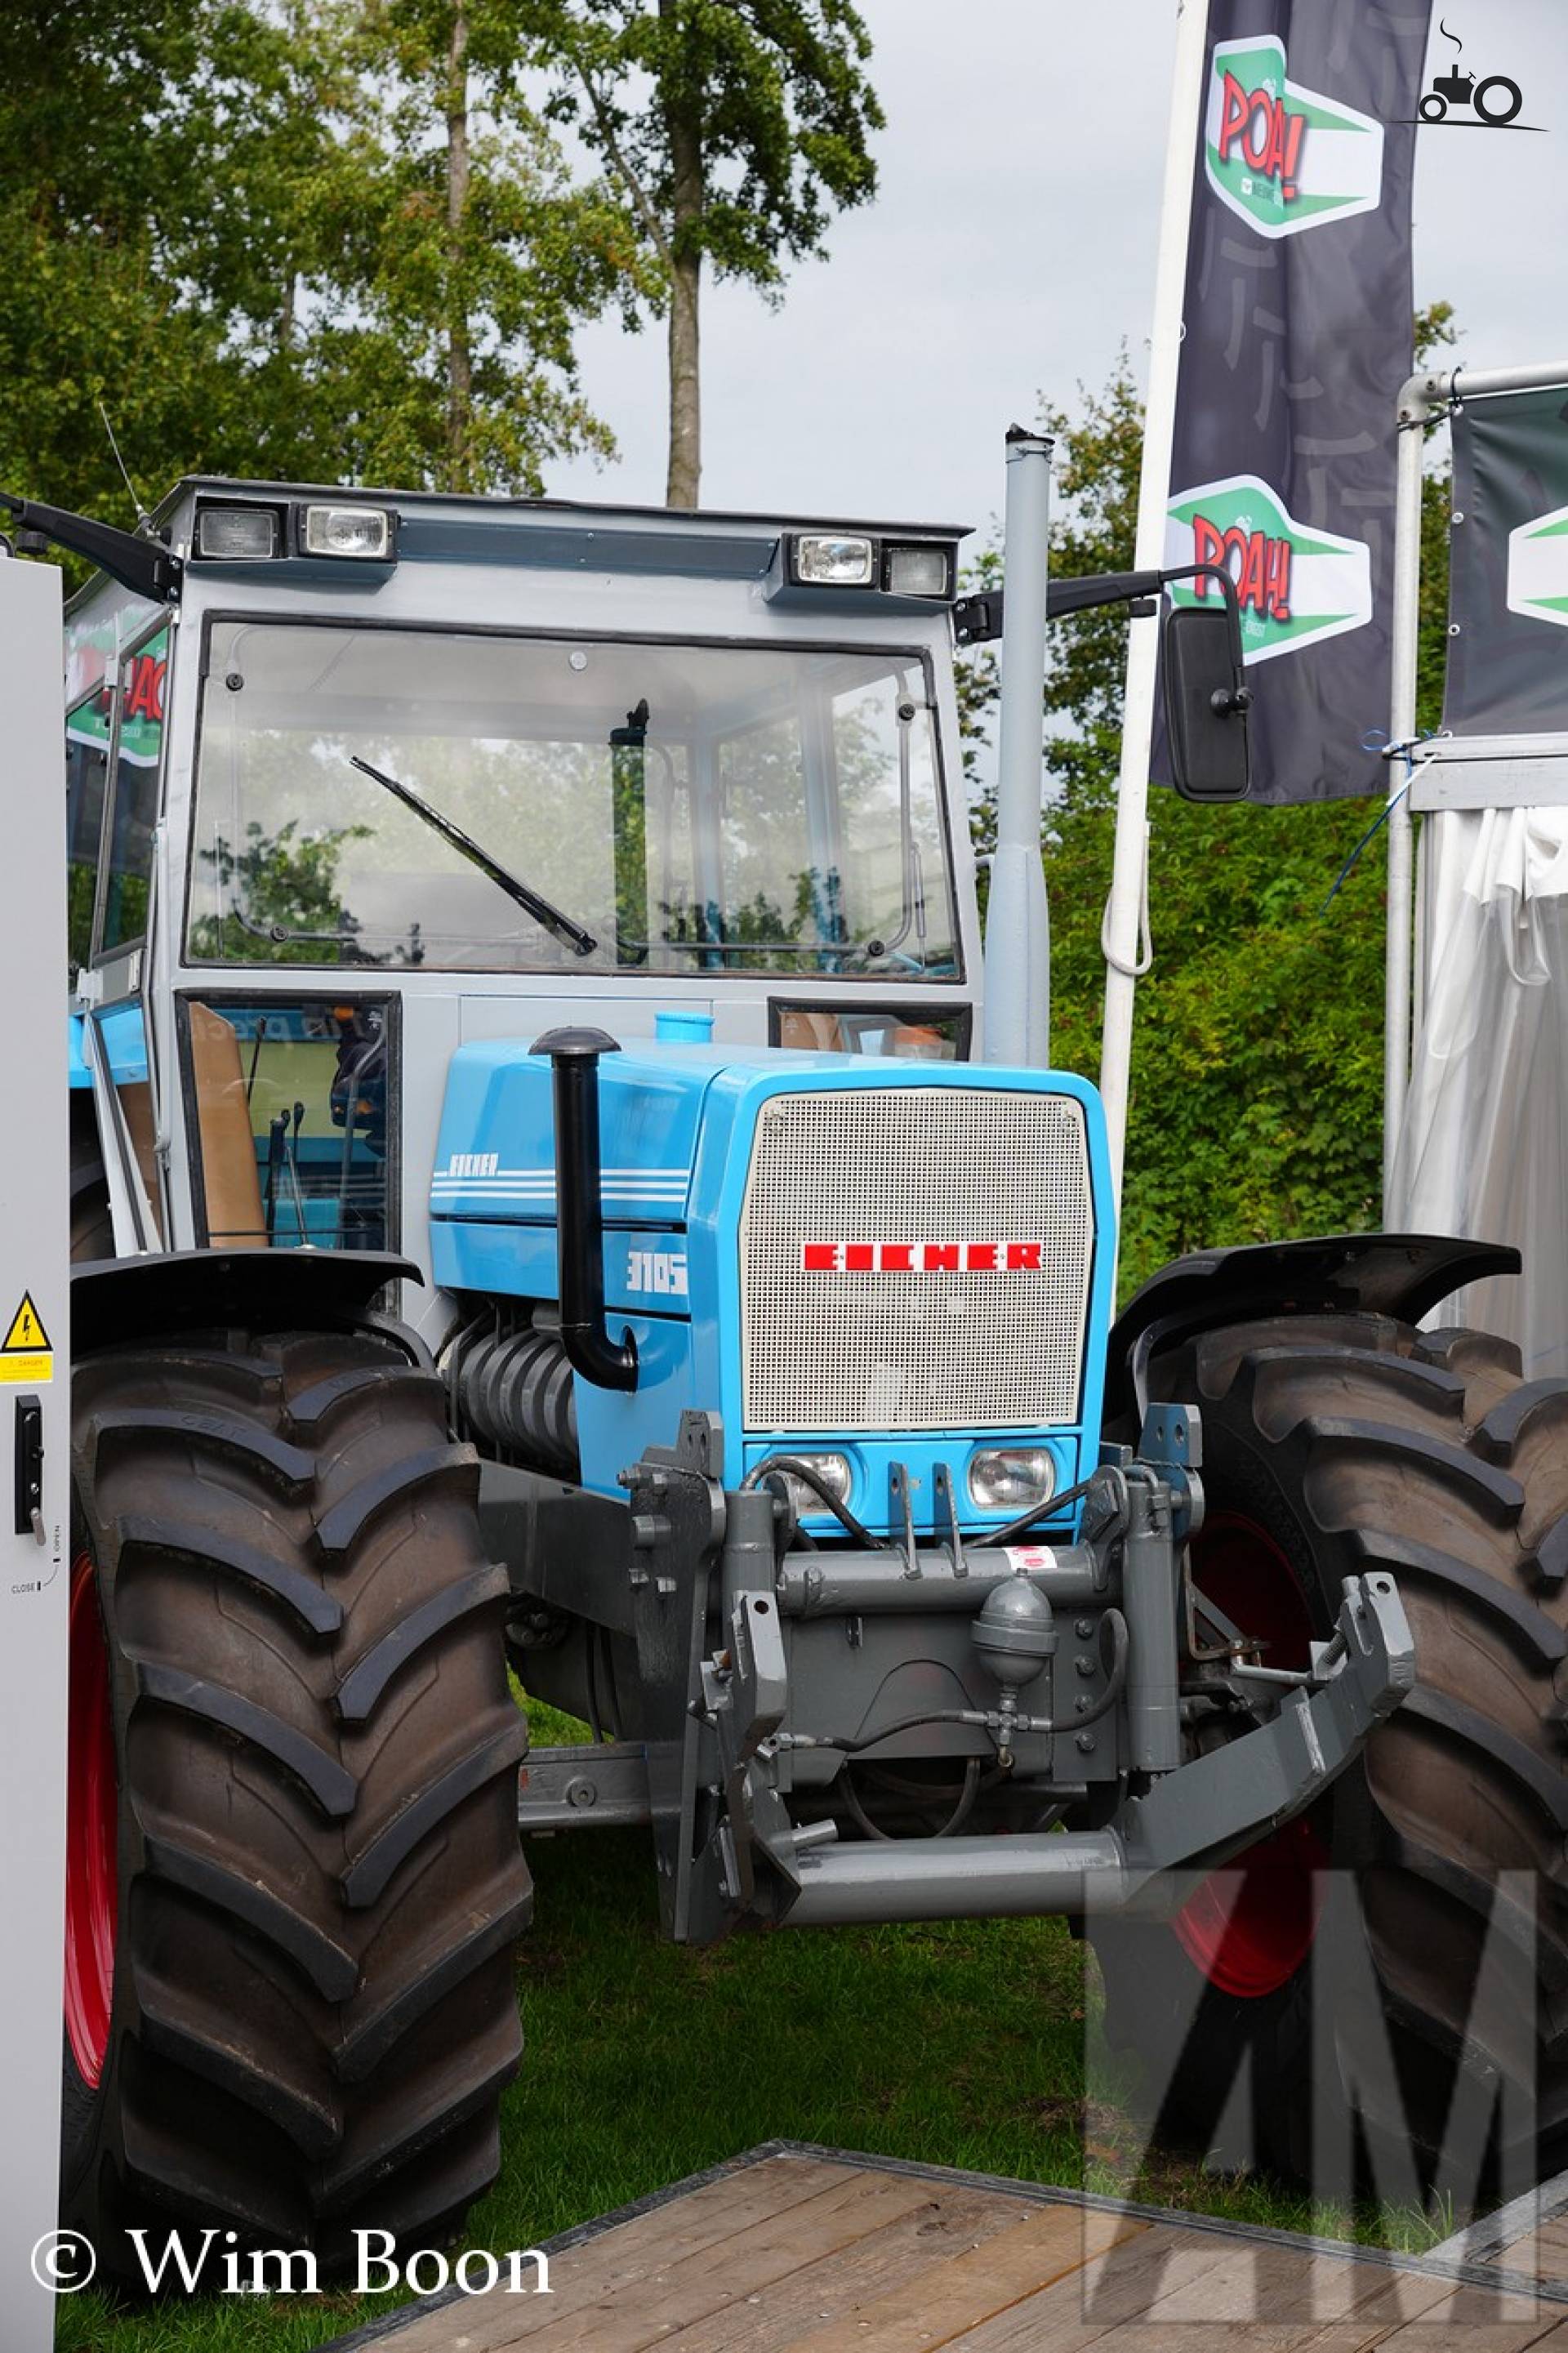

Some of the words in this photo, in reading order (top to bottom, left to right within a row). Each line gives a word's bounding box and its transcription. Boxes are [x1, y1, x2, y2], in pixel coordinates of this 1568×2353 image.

[1193, 514, 1292, 622] POAH!
[626, 1250, 688, 1295] 3105
[804, 1242, 1042, 1271] EICHER
